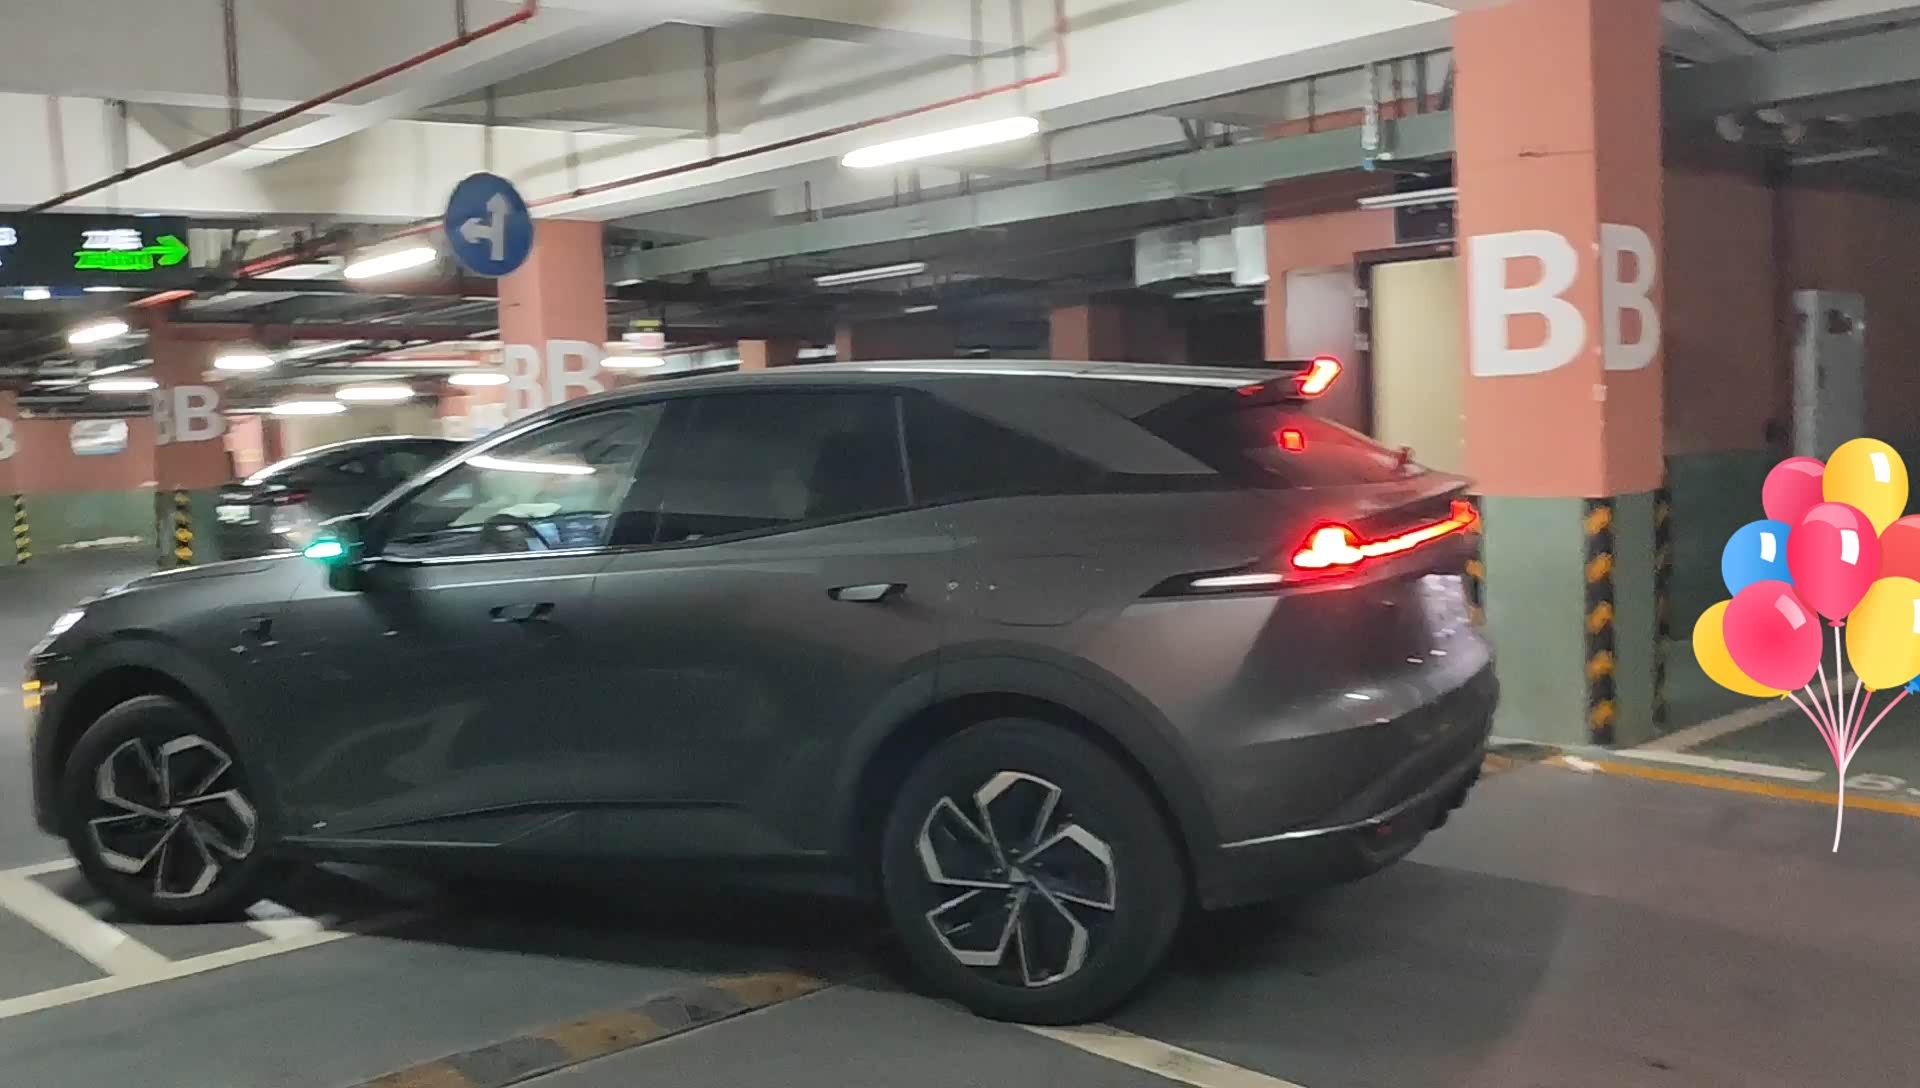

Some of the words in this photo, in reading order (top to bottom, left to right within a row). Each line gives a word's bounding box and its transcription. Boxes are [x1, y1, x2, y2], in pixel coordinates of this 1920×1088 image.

[1468, 230, 1587, 376] B
[1601, 223, 1660, 370] B
[174, 385, 226, 442] B
